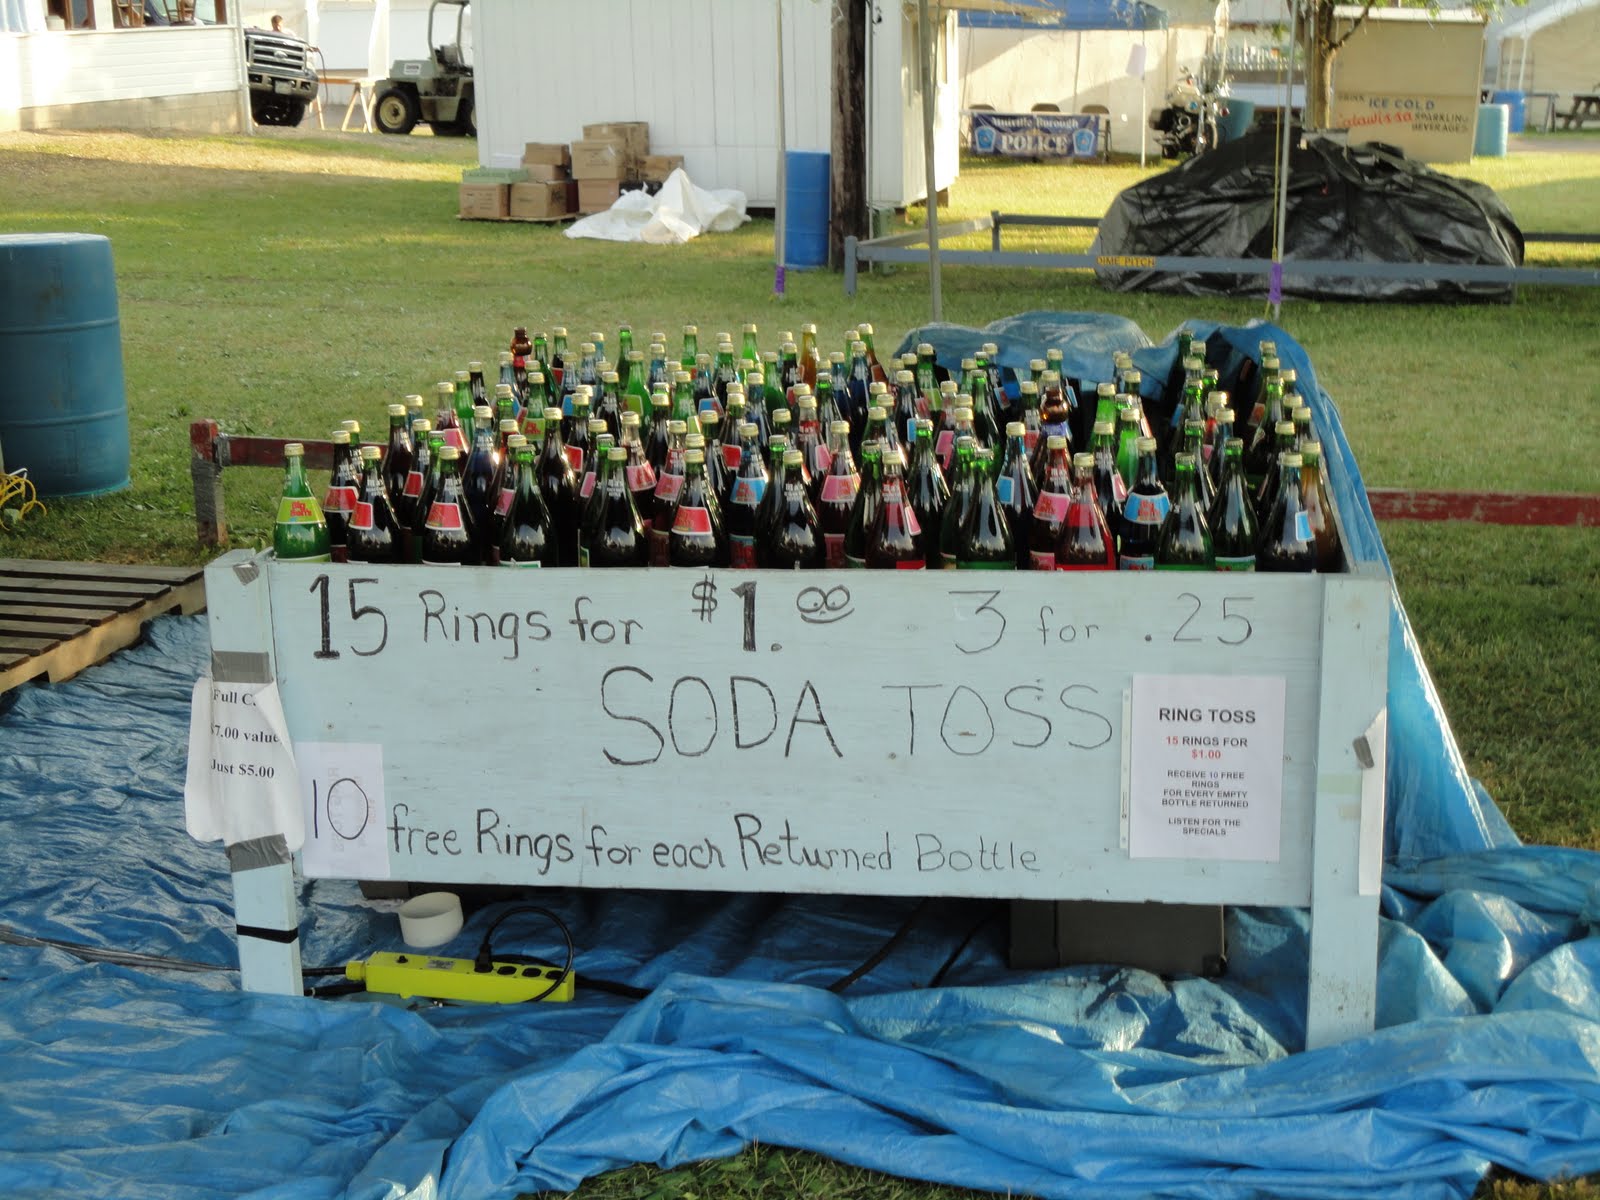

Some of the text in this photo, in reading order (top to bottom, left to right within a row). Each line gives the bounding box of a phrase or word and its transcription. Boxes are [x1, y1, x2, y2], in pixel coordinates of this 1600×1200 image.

[1368, 97, 1389, 109] ICE
[1394, 98, 1435, 111] COLD
[1001, 134, 1068, 155] POLICE
[1124, 256, 1156, 268] PITCH
[310, 573, 388, 660] 15
[418, 588, 552, 660] Rings
[568, 595, 644, 645] for
[948, 590, 1006, 654] 3
[1037, 605, 1099, 645] for
[213, 689, 238, 705] Full
[601, 665, 1113, 766] SODA TOSS
[1159, 707, 1257, 725] RING TOSS
[1165, 735, 1248, 748] 15 RINGS FOR
[1191, 748, 1222, 761] $1.00
[210, 758, 276, 779] Just $5.00
[1167, 769, 1245, 780] RECEIVE 10 FREE
[1191, 780, 1220, 789] RINGS
[1163, 788, 1248, 800] FOR EVERY EMPTY
[1161, 798, 1249, 809] BOTTLE RETURNED
[312, 777, 369, 841] 10
[387, 802, 462, 856] free
[476, 807, 575, 876] Rings
[584, 824, 642, 867] for
[652, 837, 727, 869] each
[733, 812, 893, 872] Returned
[914, 832, 1041, 872] Bottle
[1168, 817, 1241, 827] LISTEN FOR THE
[1181, 827, 1227, 837] SPECIALS
